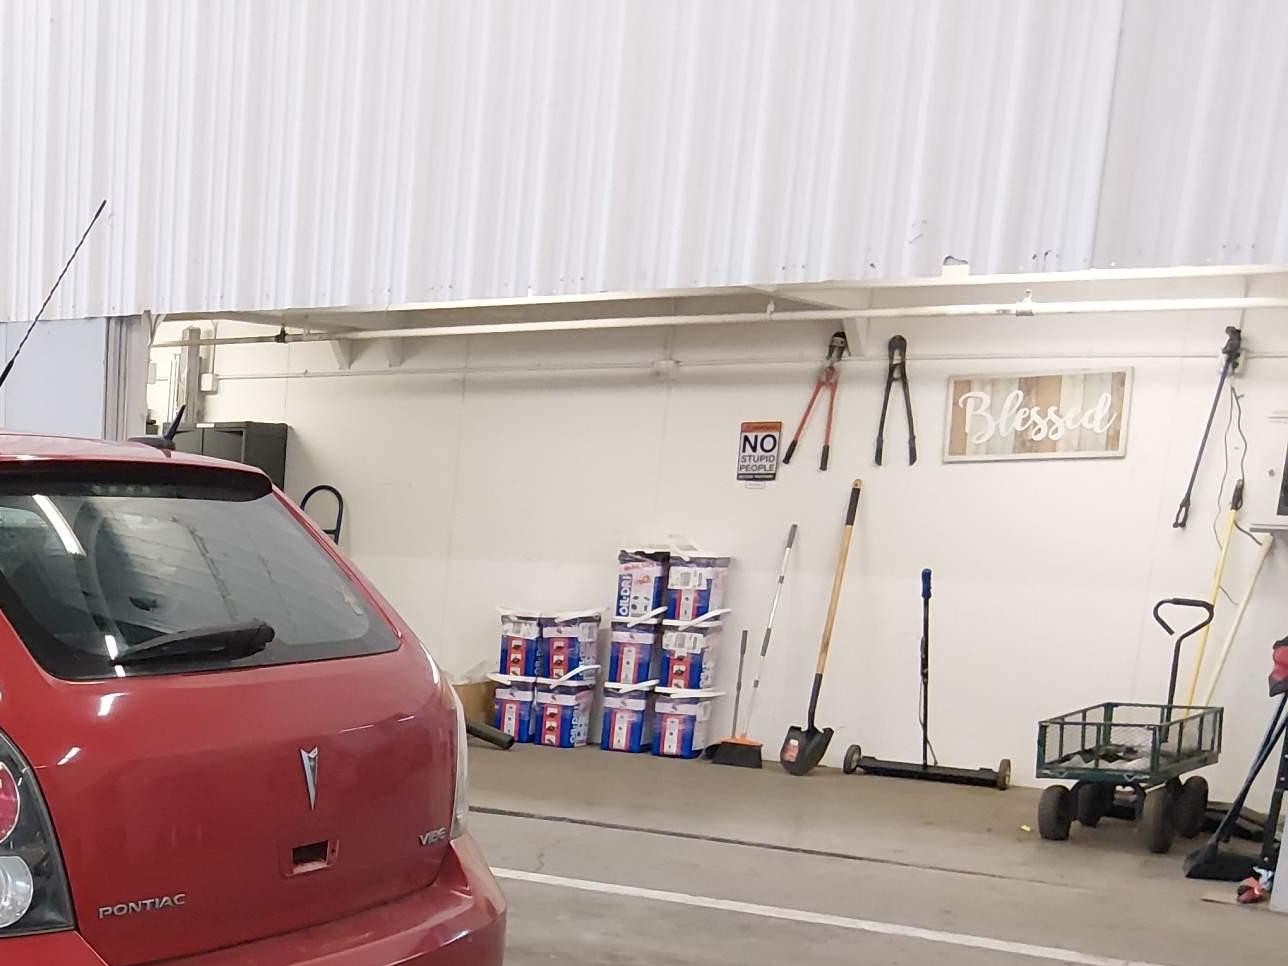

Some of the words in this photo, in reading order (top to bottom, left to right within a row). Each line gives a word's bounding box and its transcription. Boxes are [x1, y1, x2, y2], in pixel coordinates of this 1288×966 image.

[959, 390, 1117, 444] Blessed
[742, 434, 777, 453] NO
[741, 455, 775, 463] STUPID
[99, 894, 186, 919] PONTIAC
